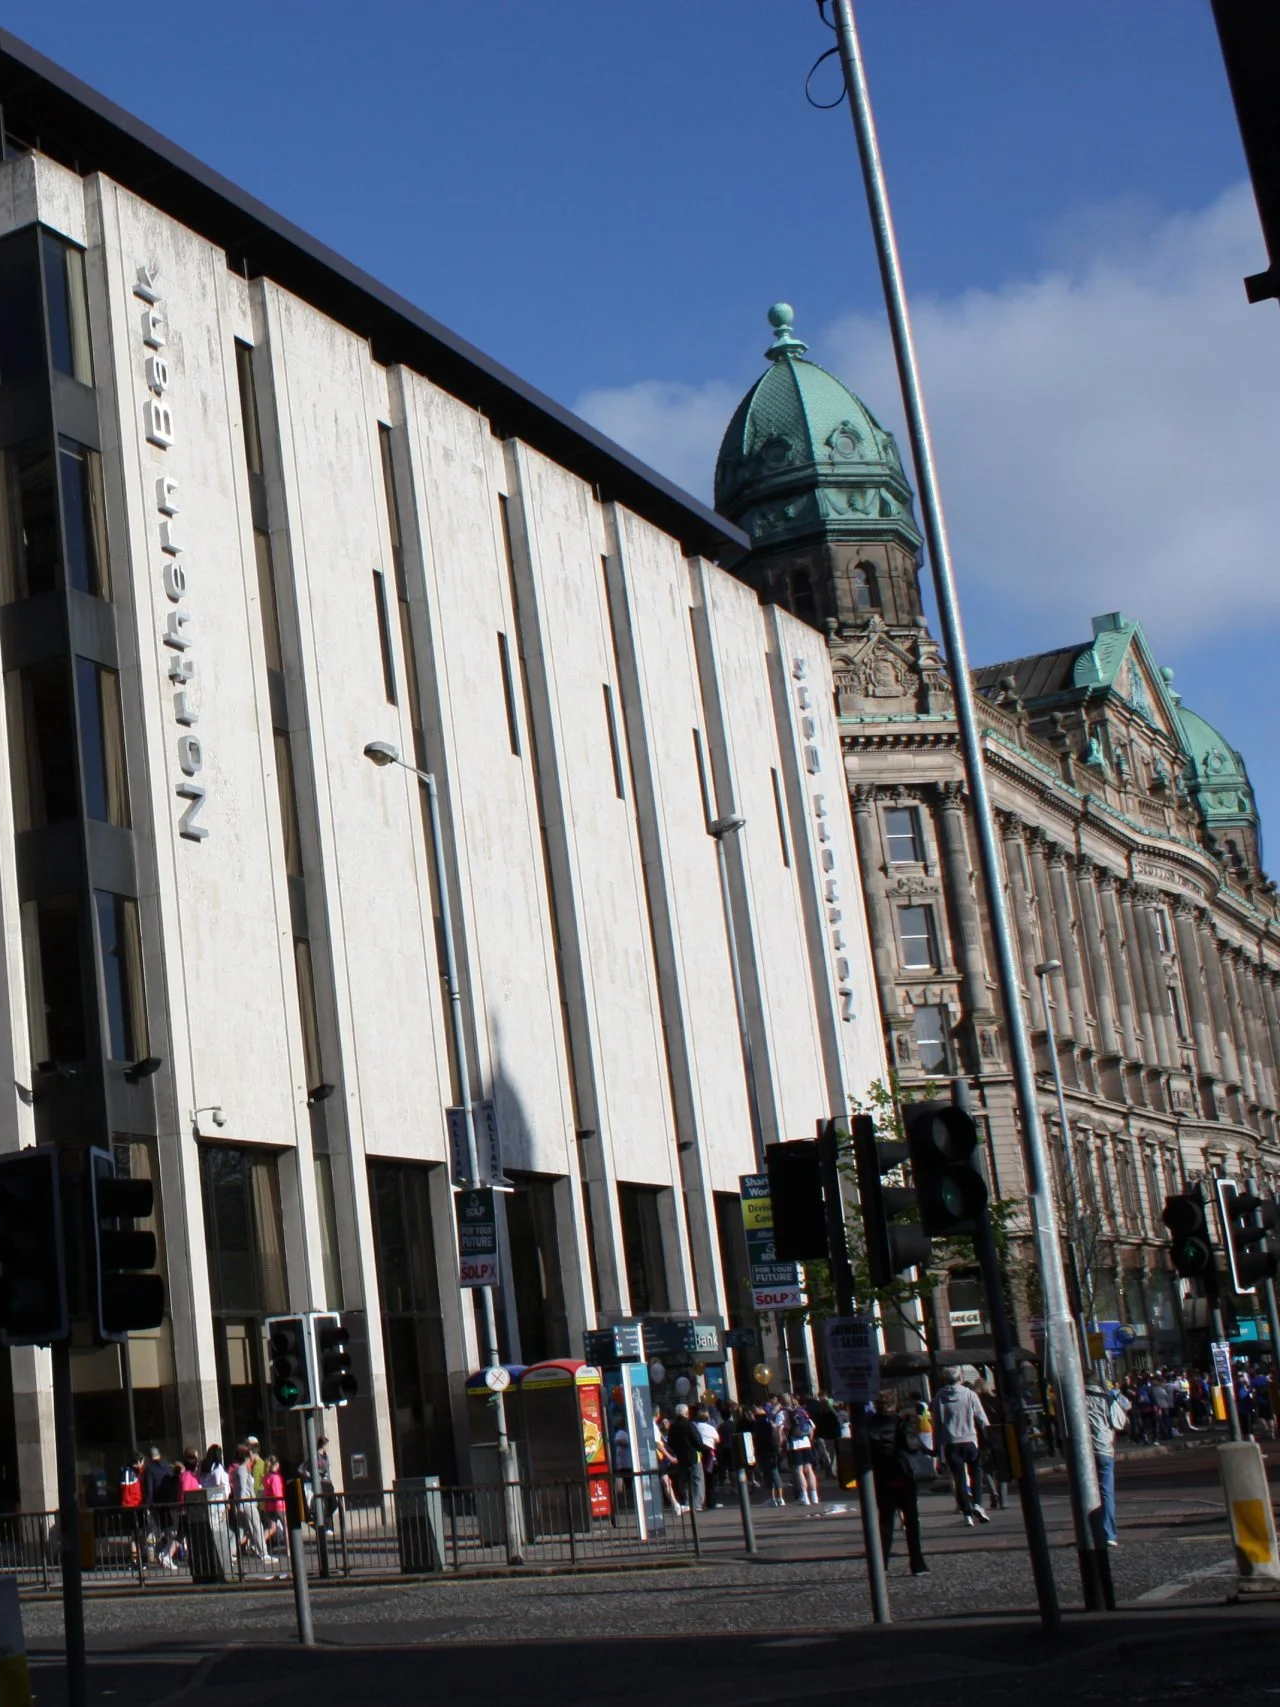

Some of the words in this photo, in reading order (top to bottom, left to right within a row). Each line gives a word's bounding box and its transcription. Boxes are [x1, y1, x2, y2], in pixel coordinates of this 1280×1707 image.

[133, 265, 175, 449] Bank
[156, 476, 209, 842] Northern
[793, 657, 821, 775] Bank
[813, 794, 856, 1022] Northern
[462, 1236, 492, 1247] FUTURE
[462, 1264, 488, 1280] SDLP
[773, 1265, 793, 1273] YOUR
[756, 1273, 793, 1282] FUTURE
[756, 1293, 788, 1305] SDLP
